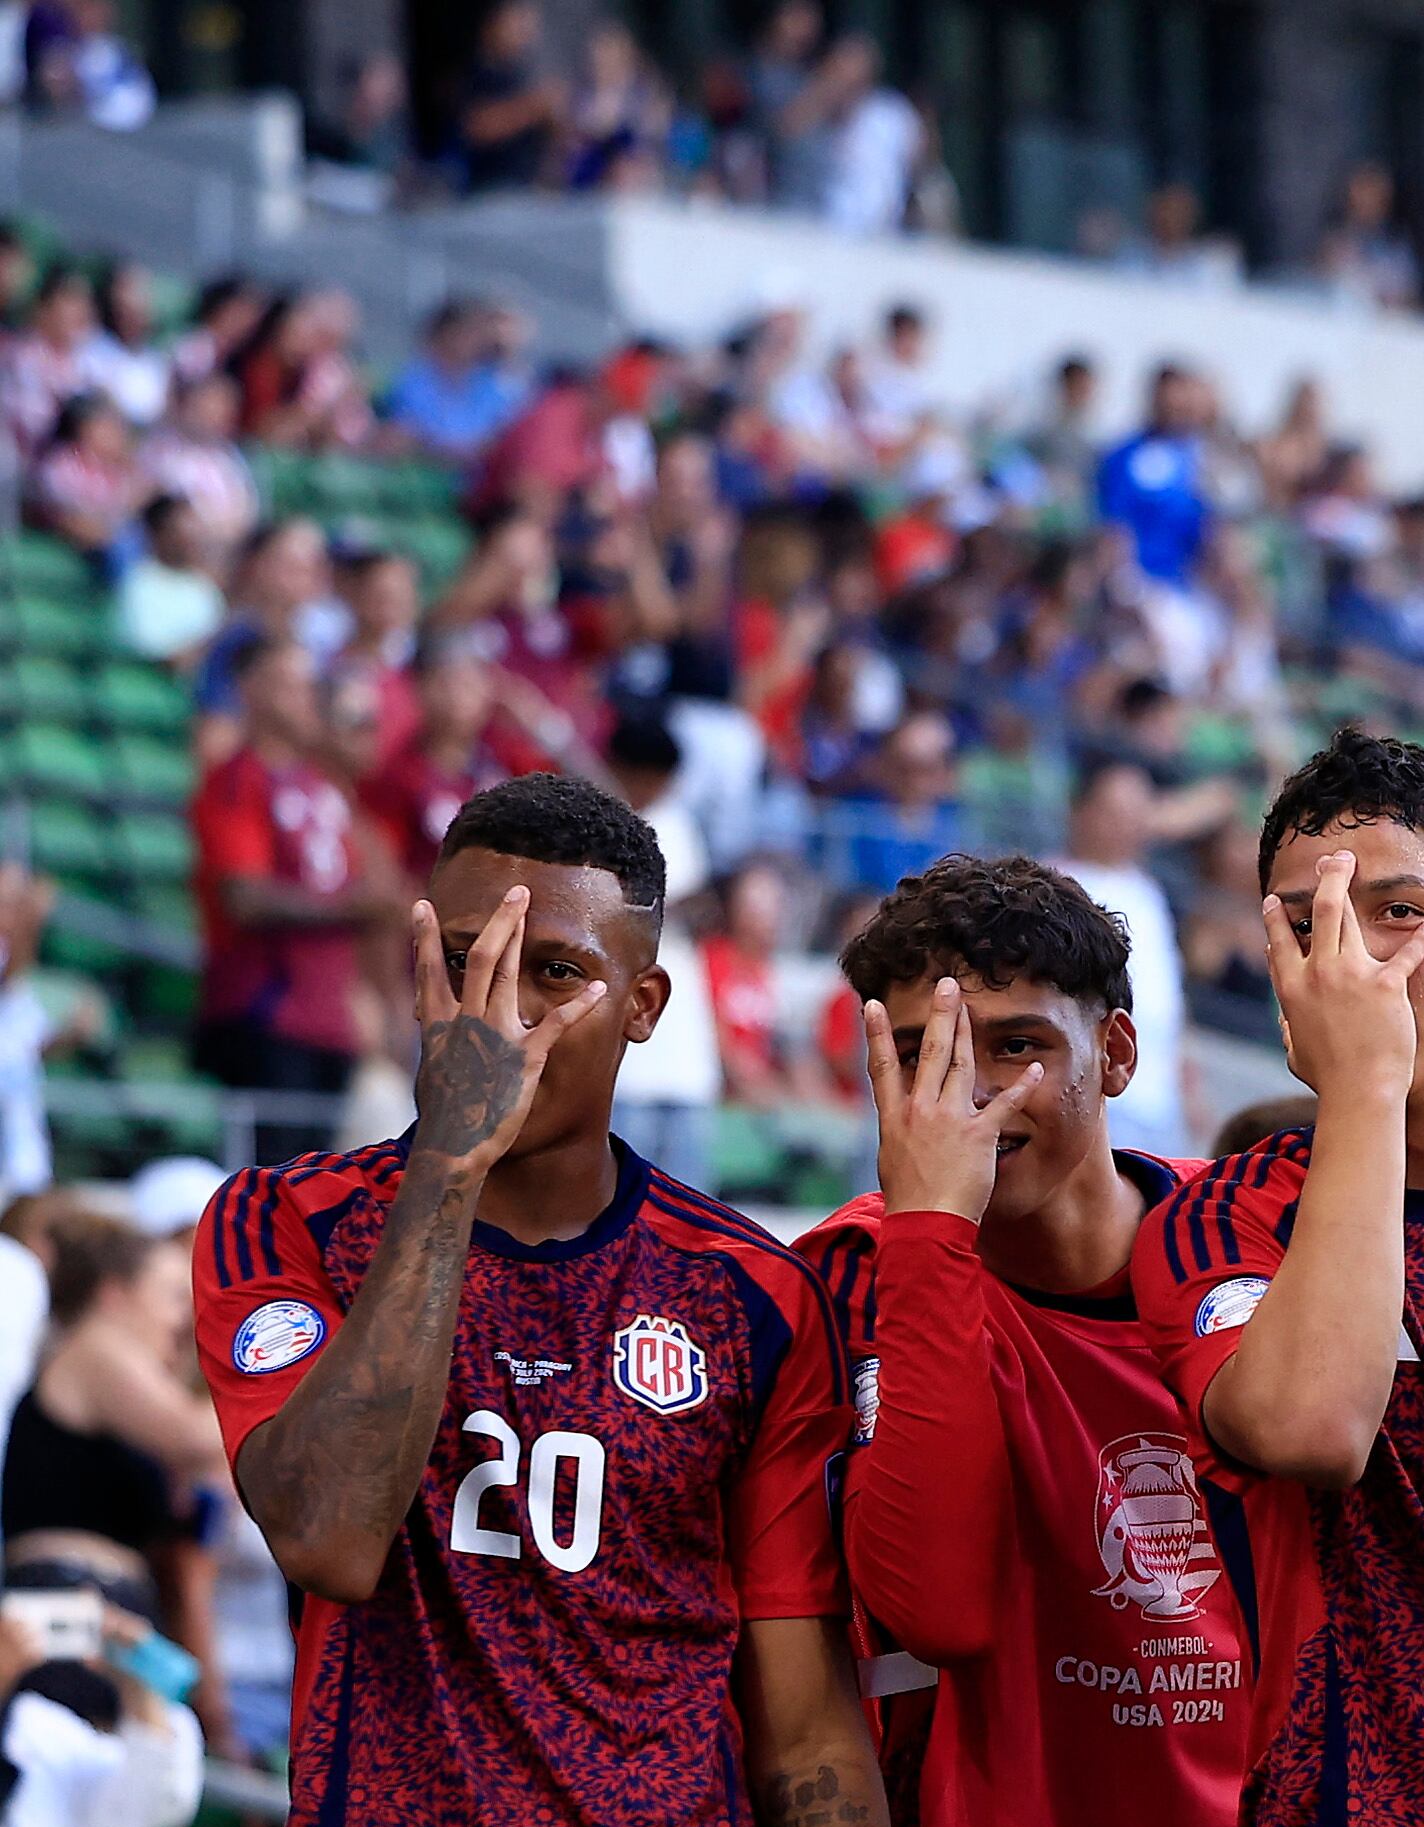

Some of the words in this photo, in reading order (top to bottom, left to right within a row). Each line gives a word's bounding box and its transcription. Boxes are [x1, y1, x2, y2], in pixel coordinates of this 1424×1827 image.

[637, 1337, 684, 1397] CR
[450, 1409, 605, 1573] 20
[1055, 1656, 1142, 1694] COPA
[1149, 1660, 1242, 1694] AMERI
[1112, 1703, 1164, 1727] USA
[1172, 1699, 1225, 1724] 2024
